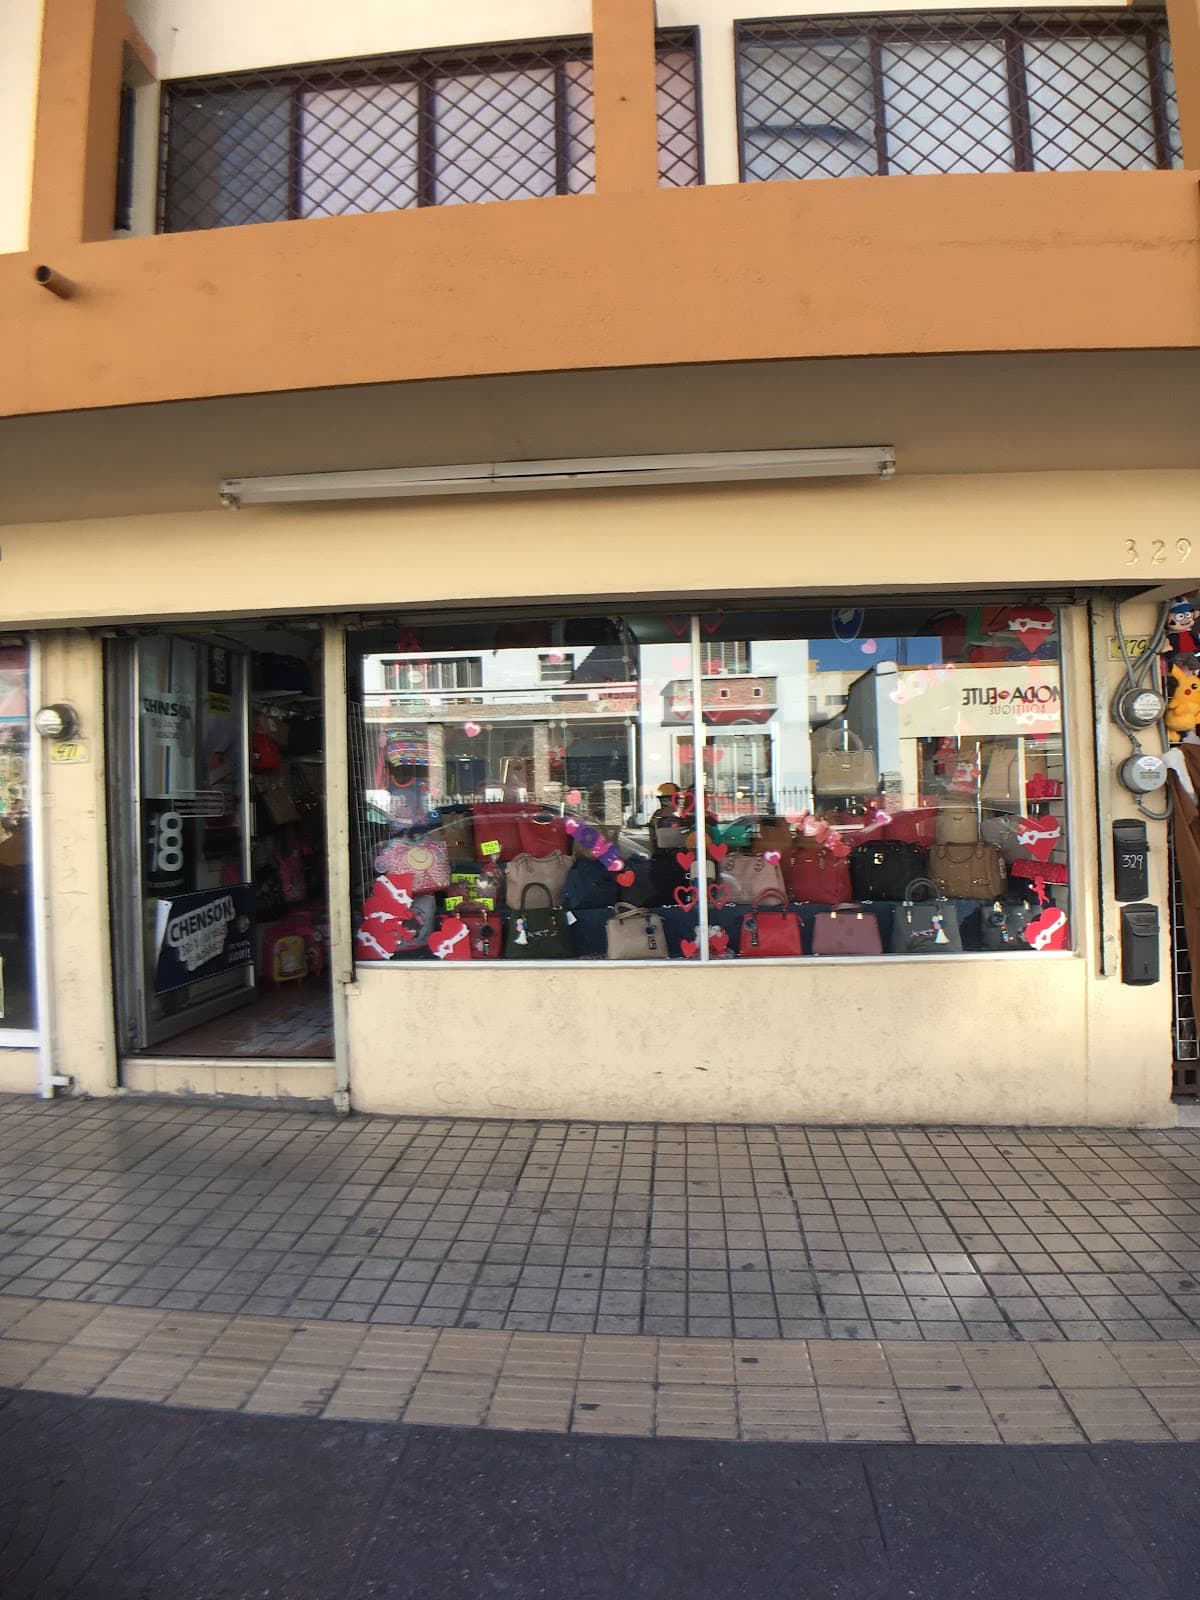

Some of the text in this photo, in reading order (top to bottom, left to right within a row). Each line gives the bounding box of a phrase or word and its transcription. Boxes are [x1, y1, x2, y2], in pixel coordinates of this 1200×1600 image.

[1123, 537, 1192, 566] 329
[1121, 854, 1144, 871] 329
[170, 900, 234, 943] CHENSON
